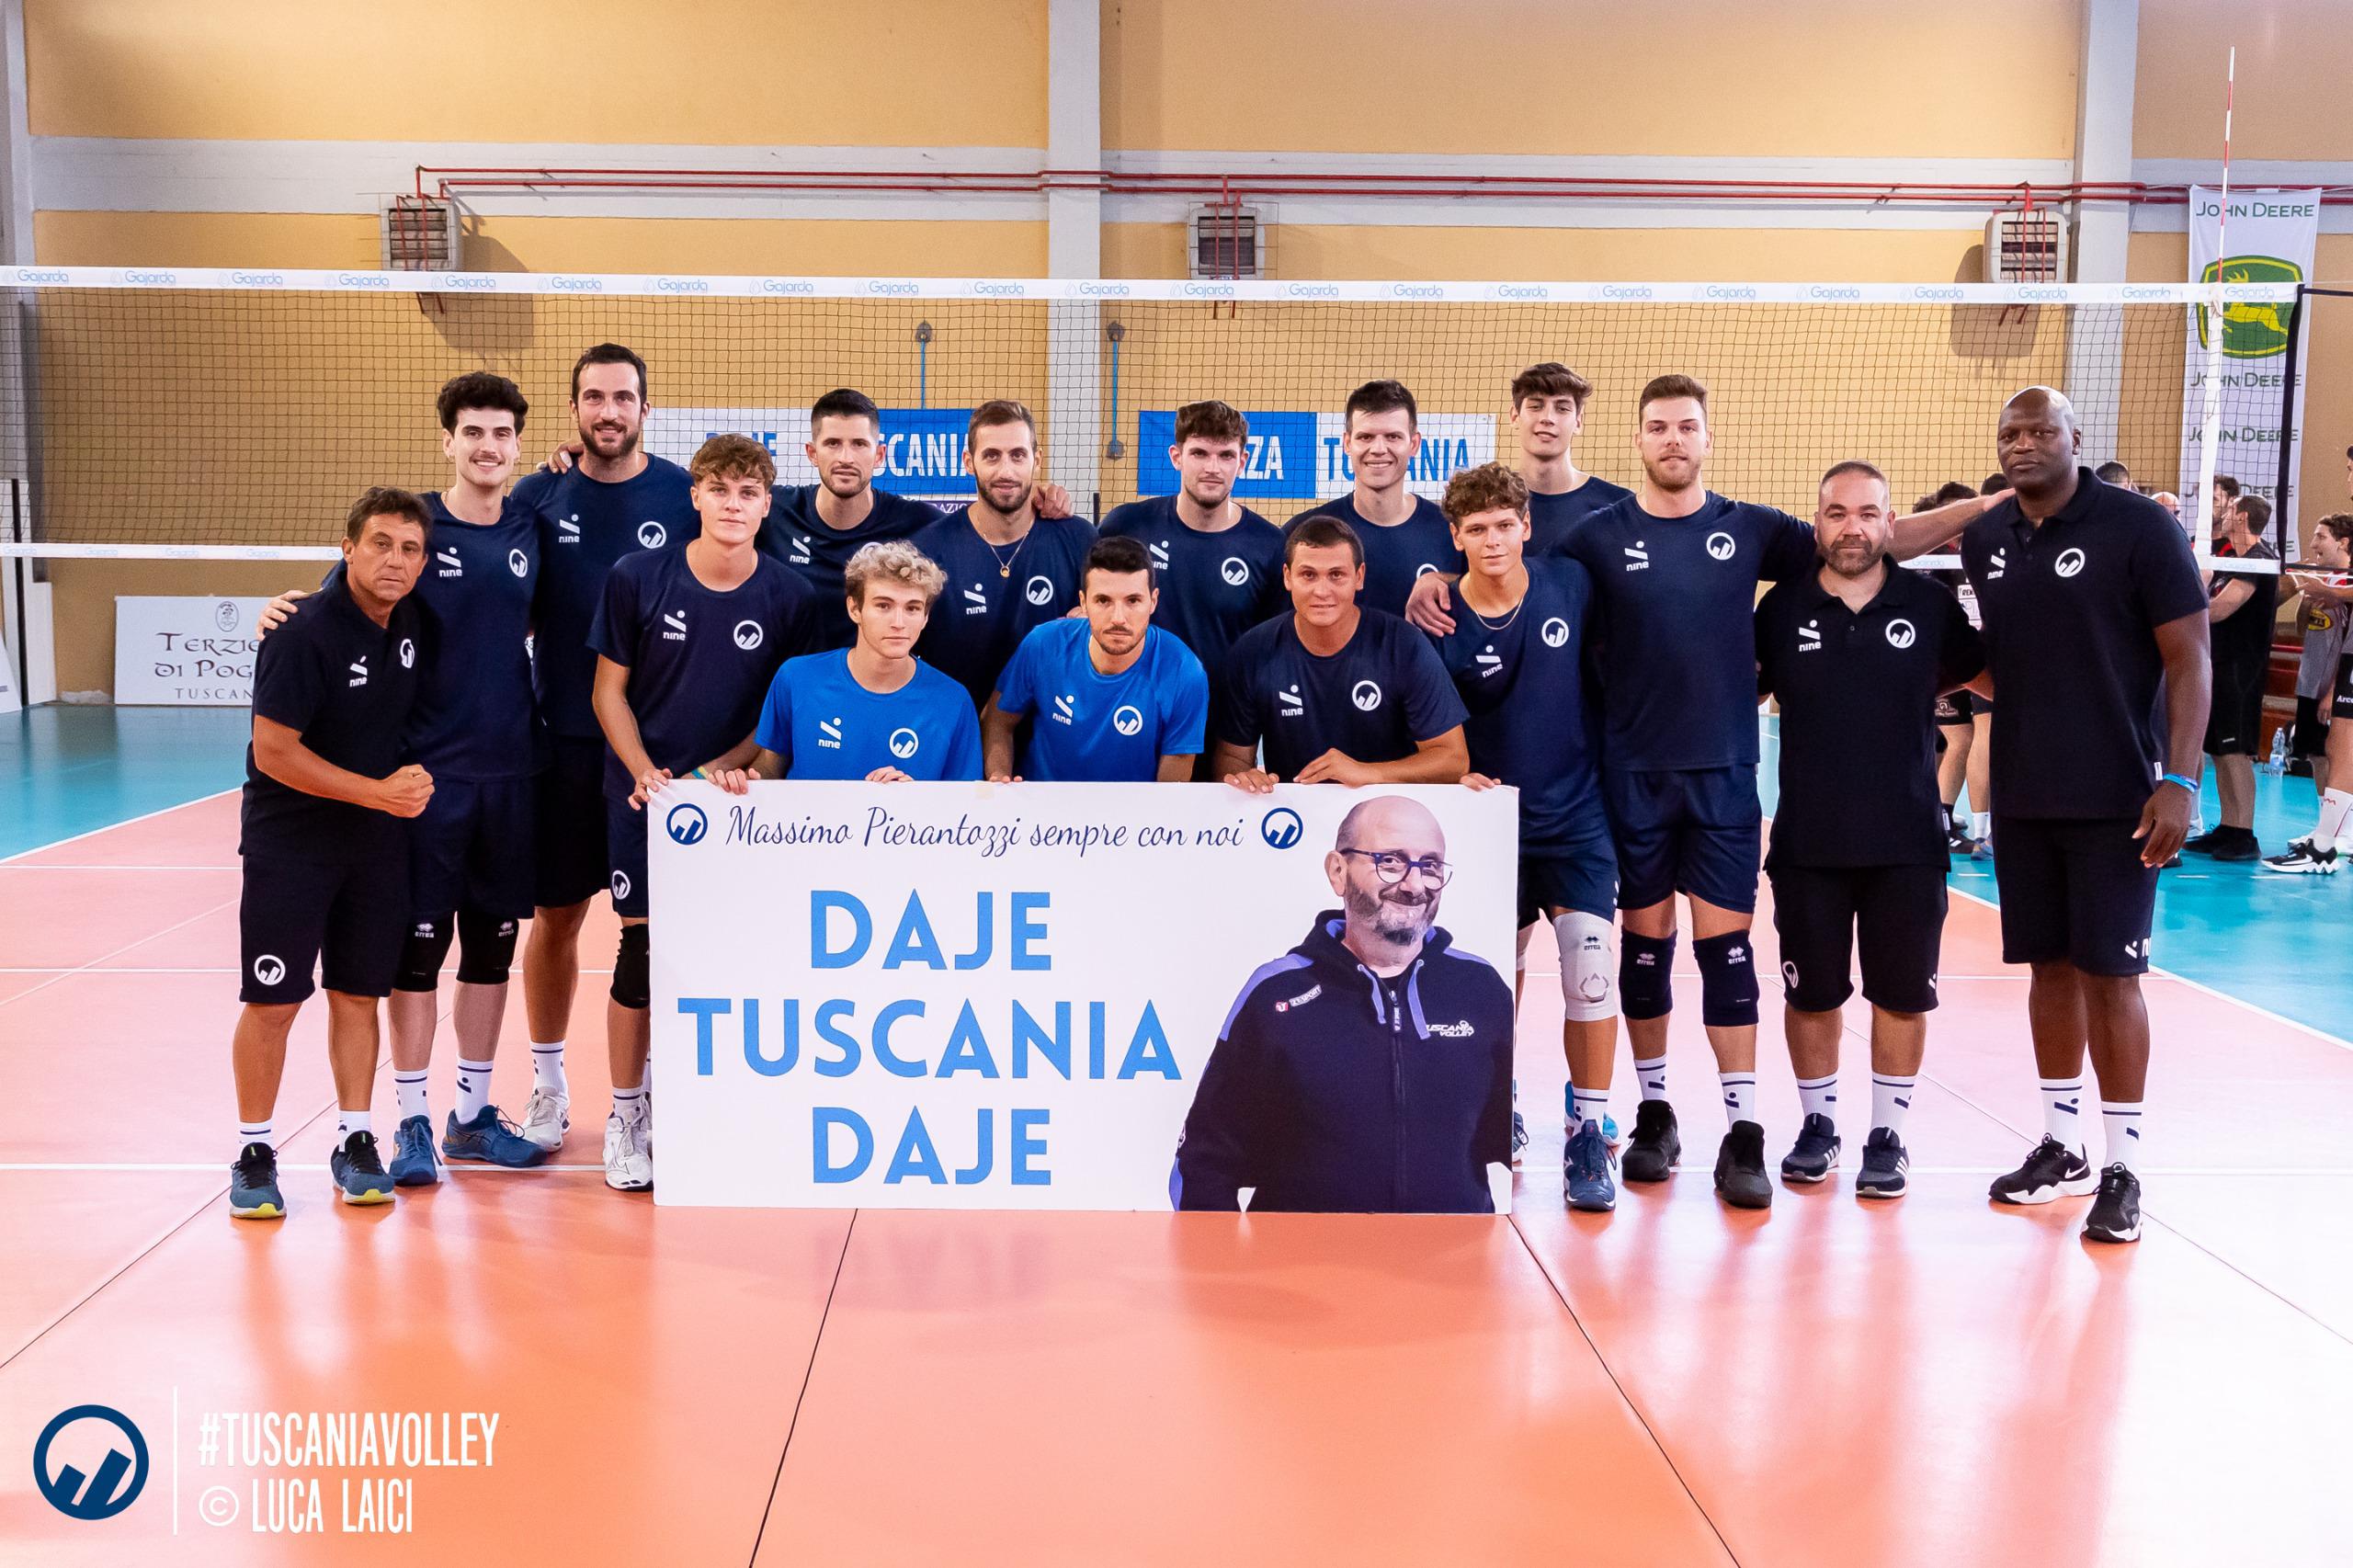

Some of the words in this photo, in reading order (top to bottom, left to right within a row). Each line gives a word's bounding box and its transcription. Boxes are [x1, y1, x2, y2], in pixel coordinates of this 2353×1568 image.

[2196, 201, 2246, 218] JOHN
[2252, 202, 2314, 218] DEERE
[2245, 372, 2302, 387] DEEE
[2188, 426, 2236, 442] JN
[559, 535, 580, 543] nine
[790, 554, 809, 564] nine
[1626, 561, 1649, 572] nine
[438, 569, 462, 577] nine
[966, 605, 987, 615] nine
[663, 631, 686, 642] nine
[1799, 642, 1821, 653] nine
[1482, 663, 1503, 678] nine
[349, 676, 367, 687] nine
[1281, 708, 1303, 717] nine
[1052, 712, 1072, 726] nine
[818, 739, 841, 749] nine
[726, 805, 853, 846] Massimo
[864, 806, 1021, 858] Pierantozzi
[1029, 823, 1128, 858] sempre
[1138, 825, 1188, 846] con
[1196, 818, 1244, 846] noi
[811, 888, 1051, 971] DAJE
[1426, 1023, 1474, 1033] USCANIA
[677, 997, 1182, 1080] TUSCANIA
[813, 1105, 1051, 1186] DAJE
